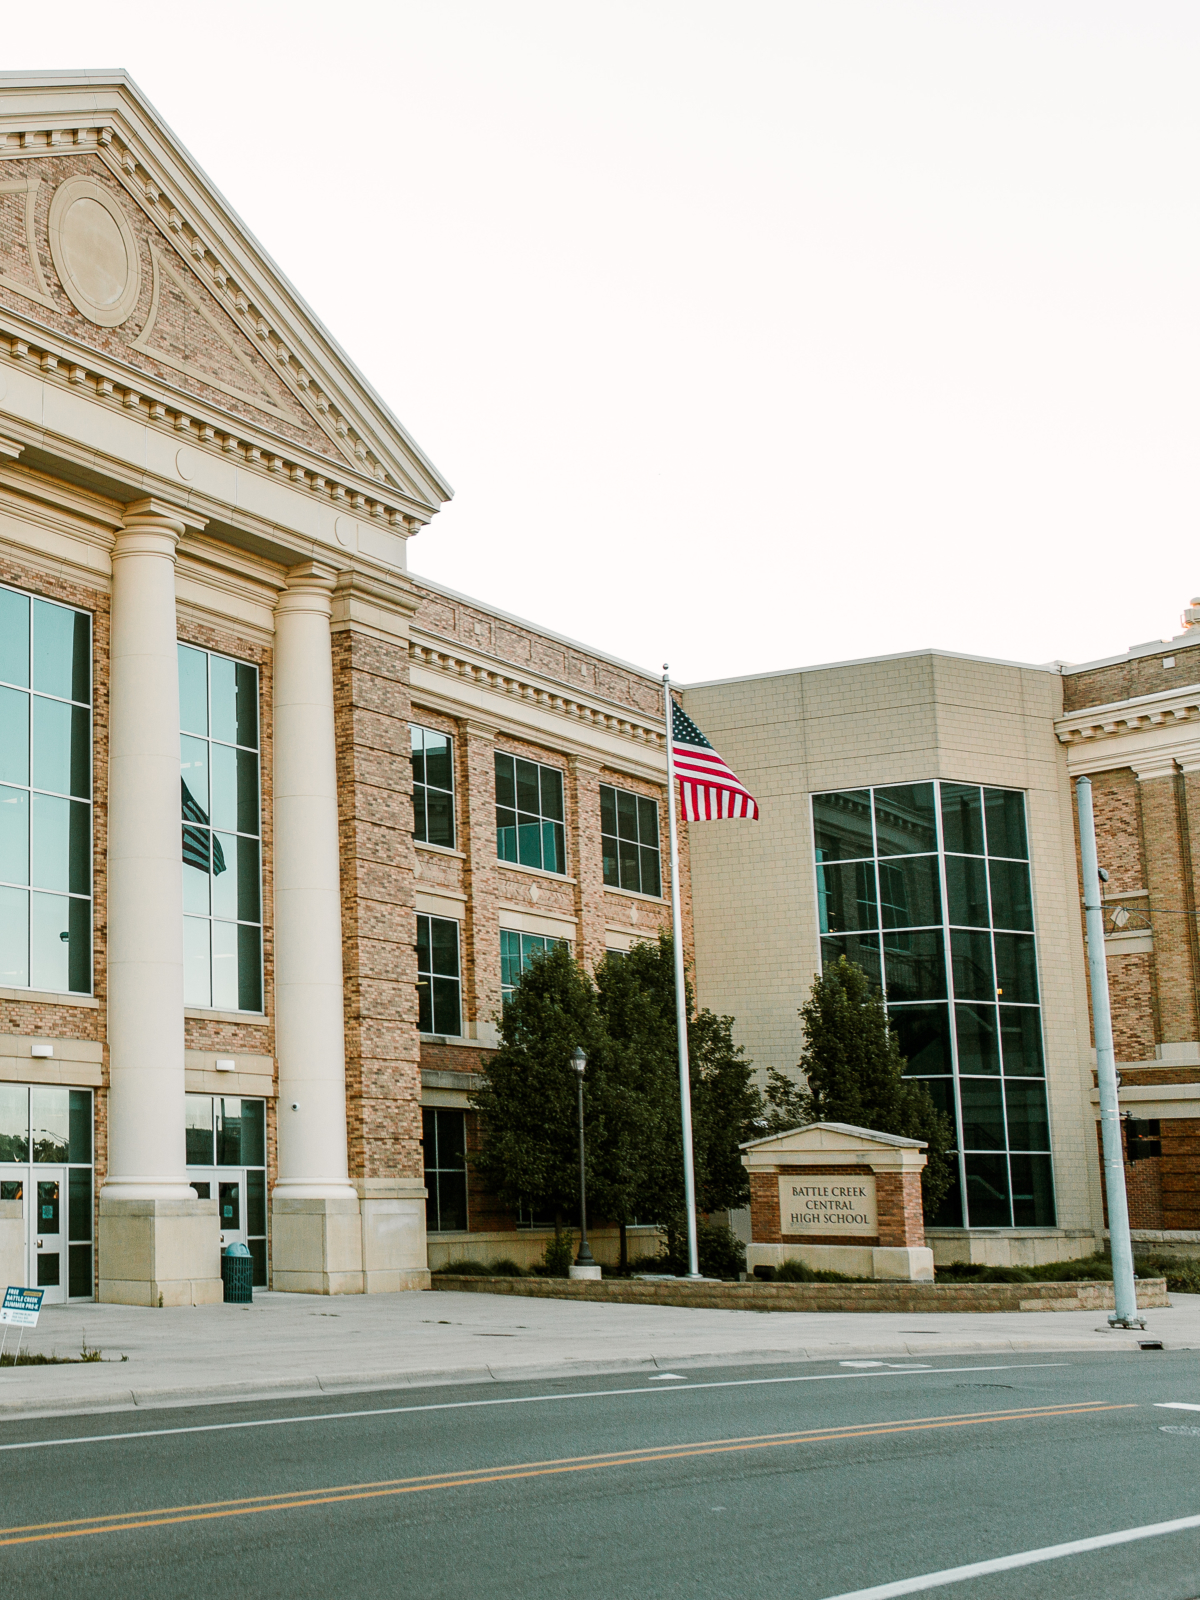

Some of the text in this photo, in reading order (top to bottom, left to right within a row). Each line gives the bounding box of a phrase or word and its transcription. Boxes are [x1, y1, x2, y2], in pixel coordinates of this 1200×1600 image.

[792, 1187, 867, 1197] BATTLE CREEK
[805, 1200, 855, 1211] CENTRAL
[790, 1213, 870, 1225] HIGH SCHOOL
[4, 1301, 25, 1309] SUMMER
